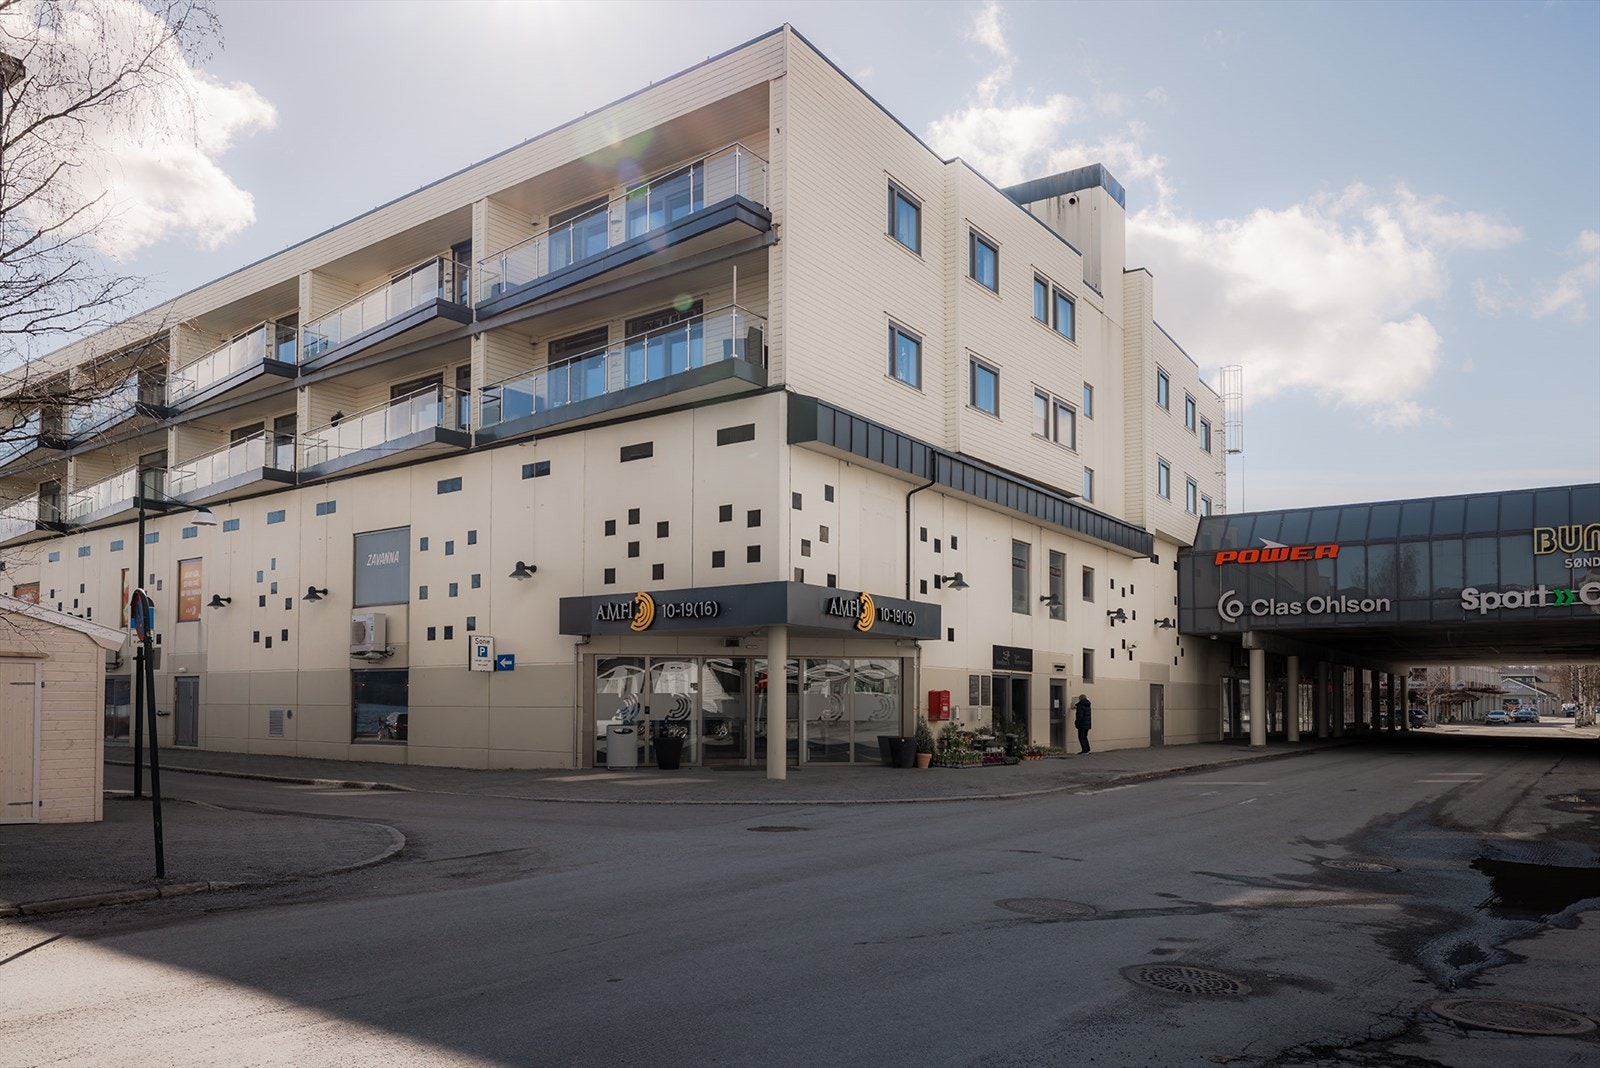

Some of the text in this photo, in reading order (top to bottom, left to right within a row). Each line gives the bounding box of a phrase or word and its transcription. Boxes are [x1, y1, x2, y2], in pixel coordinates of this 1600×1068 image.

[366, 550, 400, 566] ZAVANNA
[1215, 544, 1339, 565] POWER
[1564, 557, 1600, 569] SØND
[1251, 598, 1302, 616] Clas
[1306, 595, 1391, 614] Ohlson
[1461, 585, 1548, 614] Sport
[596, 600, 718, 621] AMFI 10-19(16)
[829, 597, 917, 627] AMFI 10-19(16)
[474, 637, 490, 645] Sone
